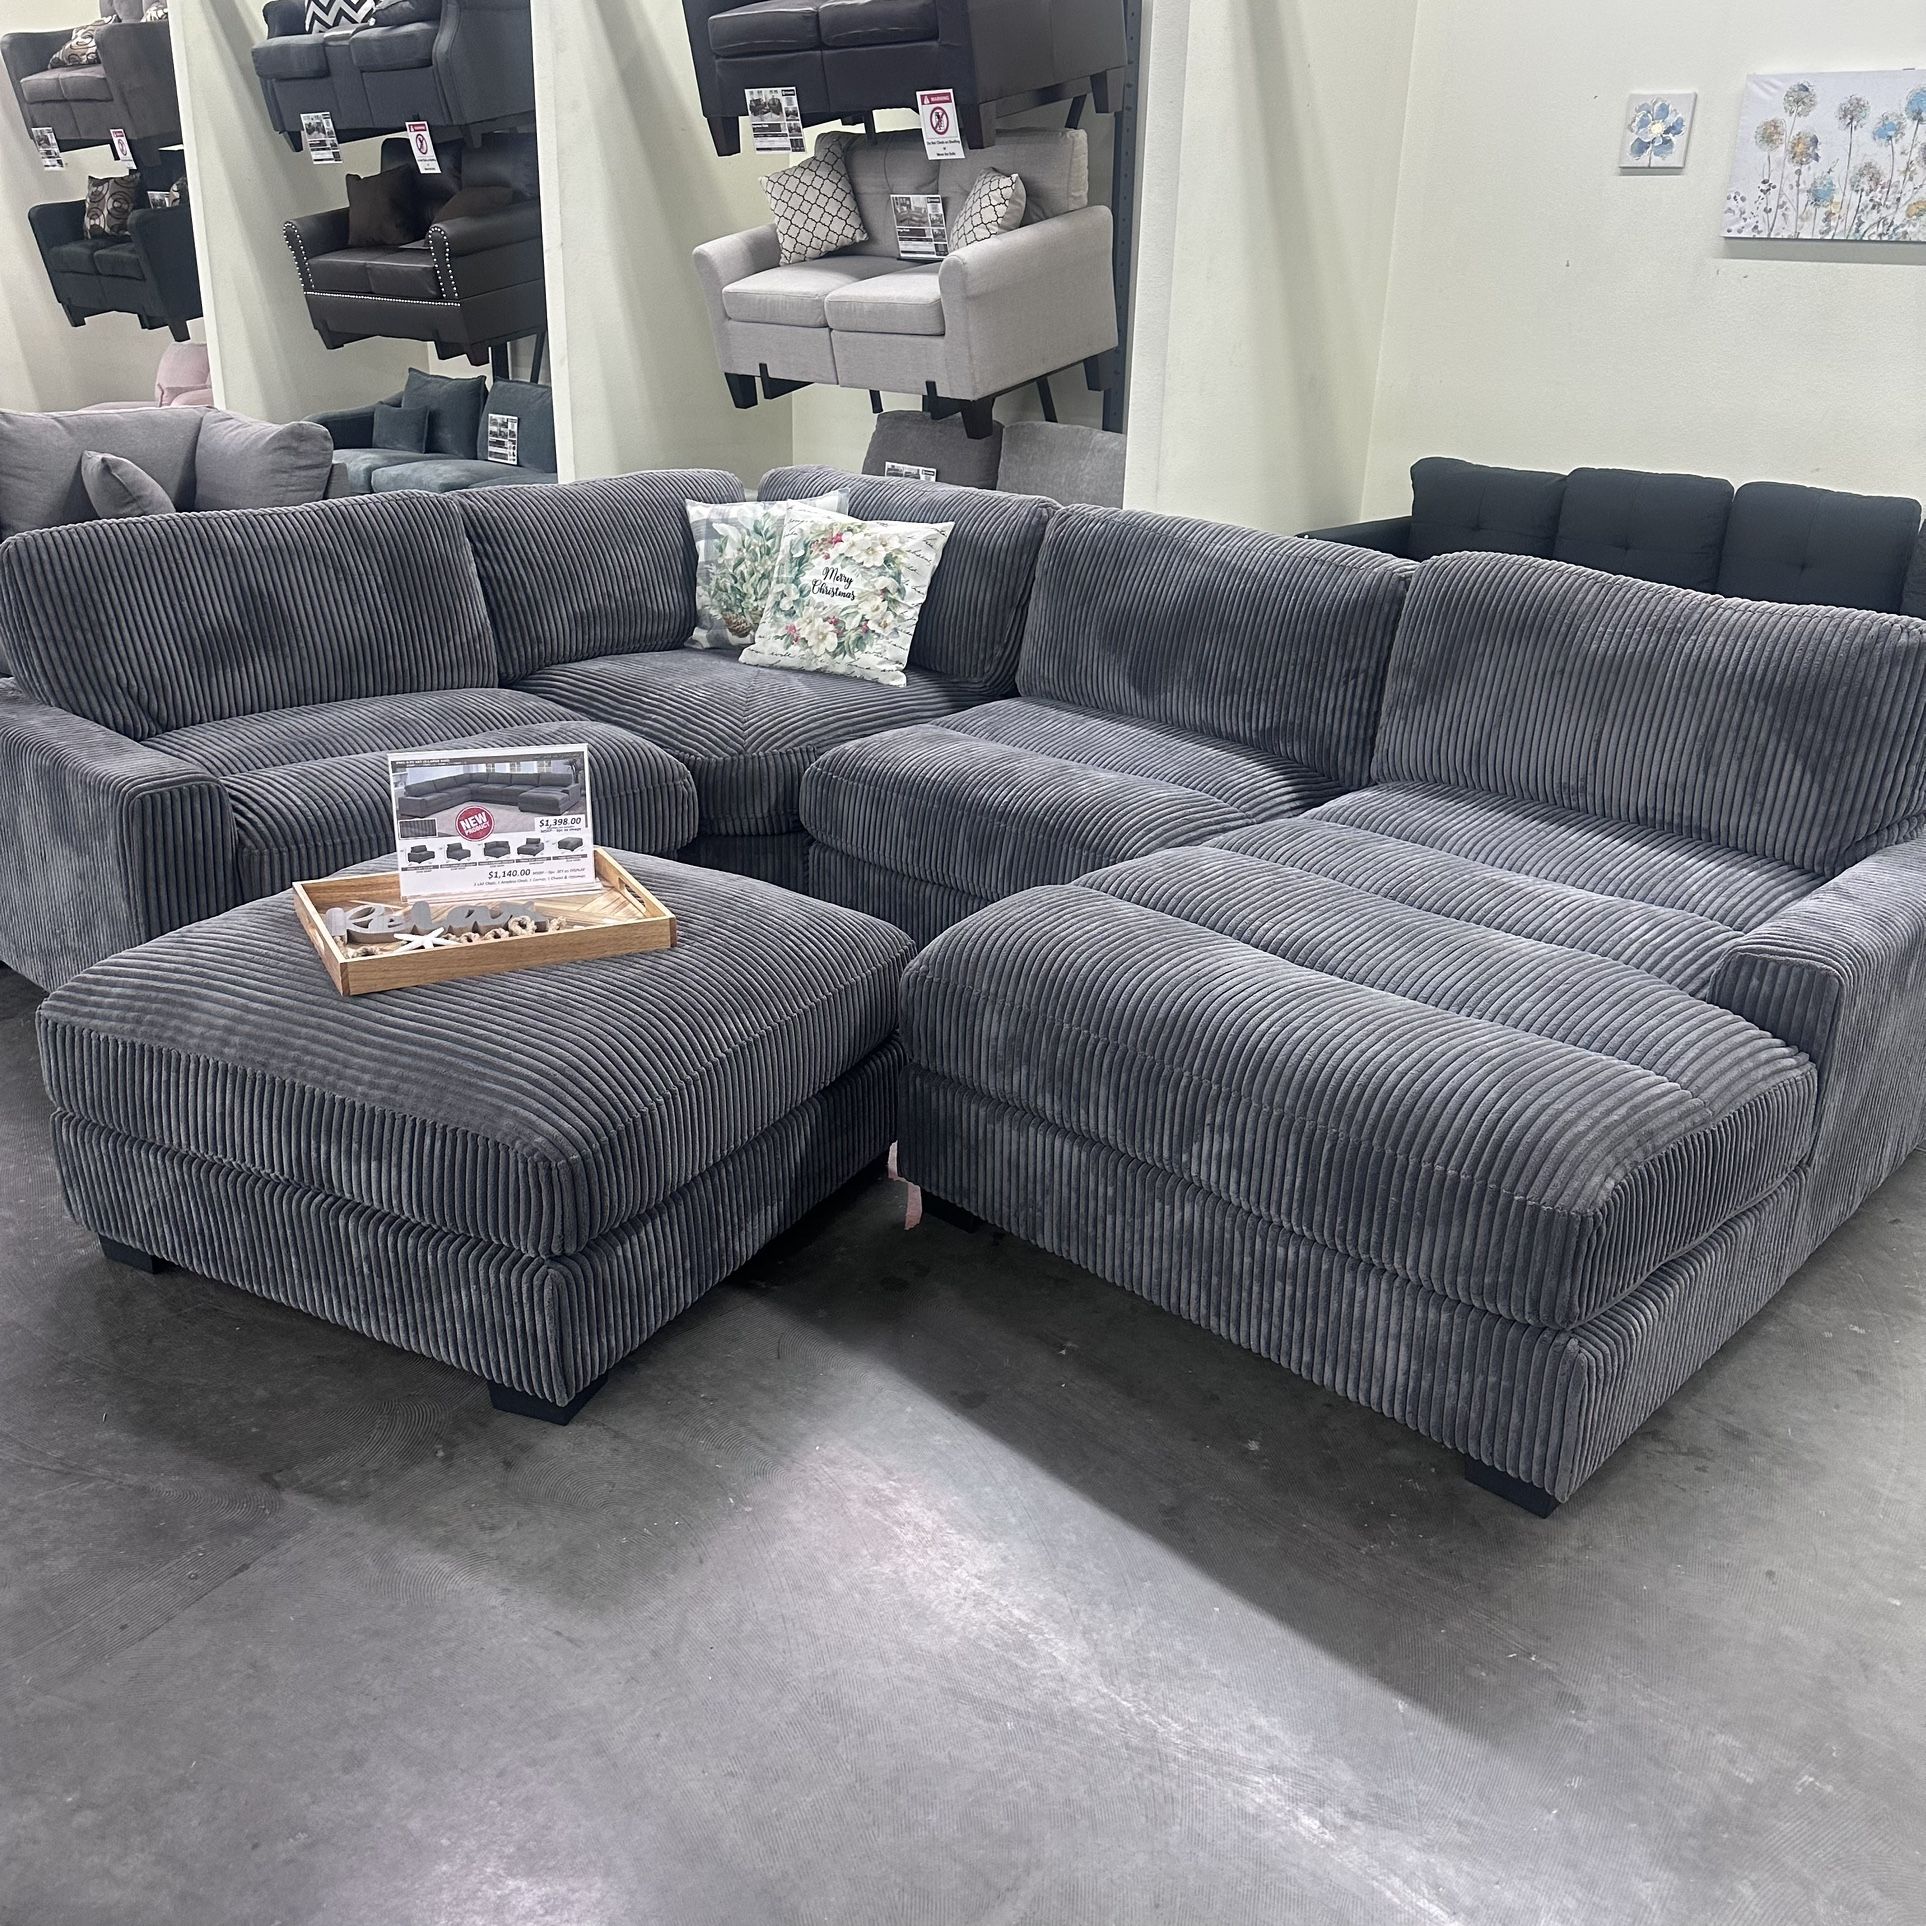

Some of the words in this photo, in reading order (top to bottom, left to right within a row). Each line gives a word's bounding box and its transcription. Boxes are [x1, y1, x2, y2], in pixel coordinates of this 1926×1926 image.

[822, 566, 853, 589] Merry
[811, 578, 856, 601] Christmas
[460, 811, 488, 830] NEW
[465, 821, 490, 835] PRODUCT
[539, 817, 582, 828] $1,398.00
[488, 868, 531, 880] $1,140.00
